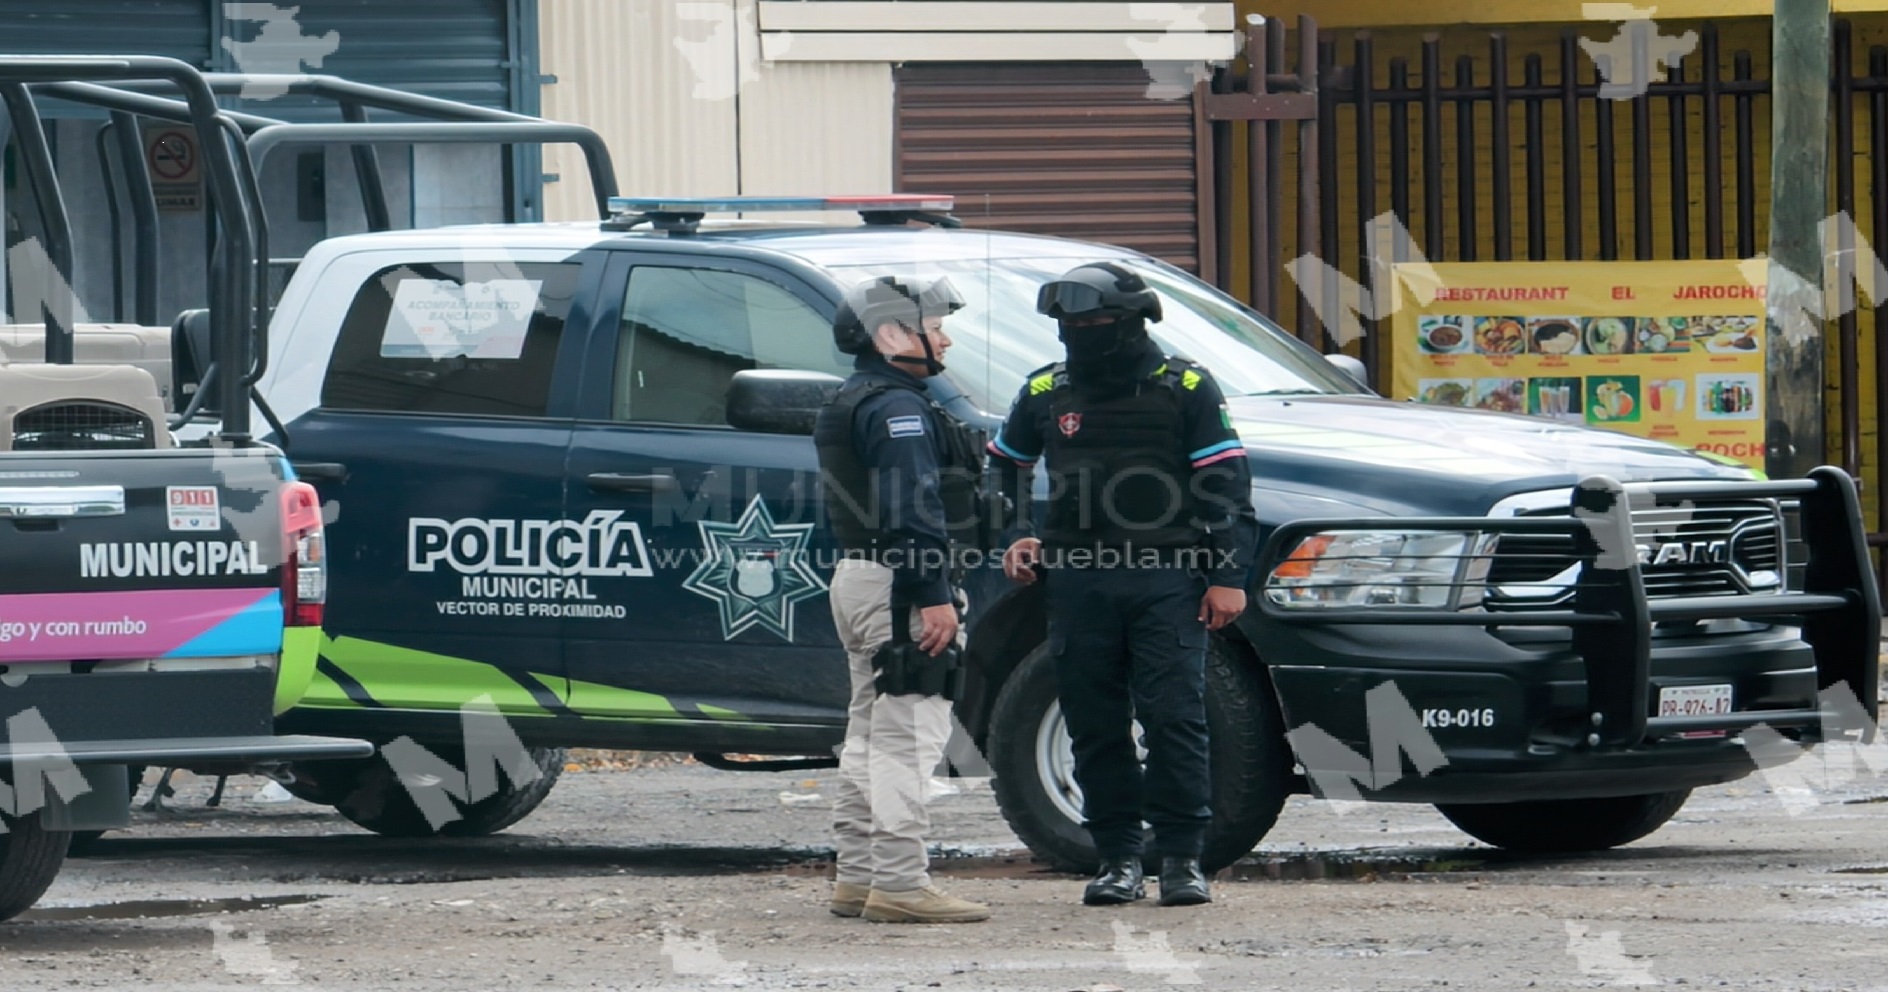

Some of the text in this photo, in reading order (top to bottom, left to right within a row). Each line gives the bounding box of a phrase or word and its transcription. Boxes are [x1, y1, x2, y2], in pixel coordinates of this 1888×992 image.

[1435, 284, 1766, 301] RESTAURANT EL JAROCHO
[172, 491, 211, 506] 911
[408, 509, 654, 577] POLICÍA
[1634, 541, 1727, 565] RAM
[80, 541, 268, 577] MUNICIPAL
[462, 576, 597, 599] MUNICIPAL
[436, 602, 627, 619] VECTOR DE PROXIMIDAD
[29, 622, 41, 641] y
[45, 622, 79, 636] con
[84, 615, 147, 635] rumbo
[1422, 708, 1495, 728] K9-016
